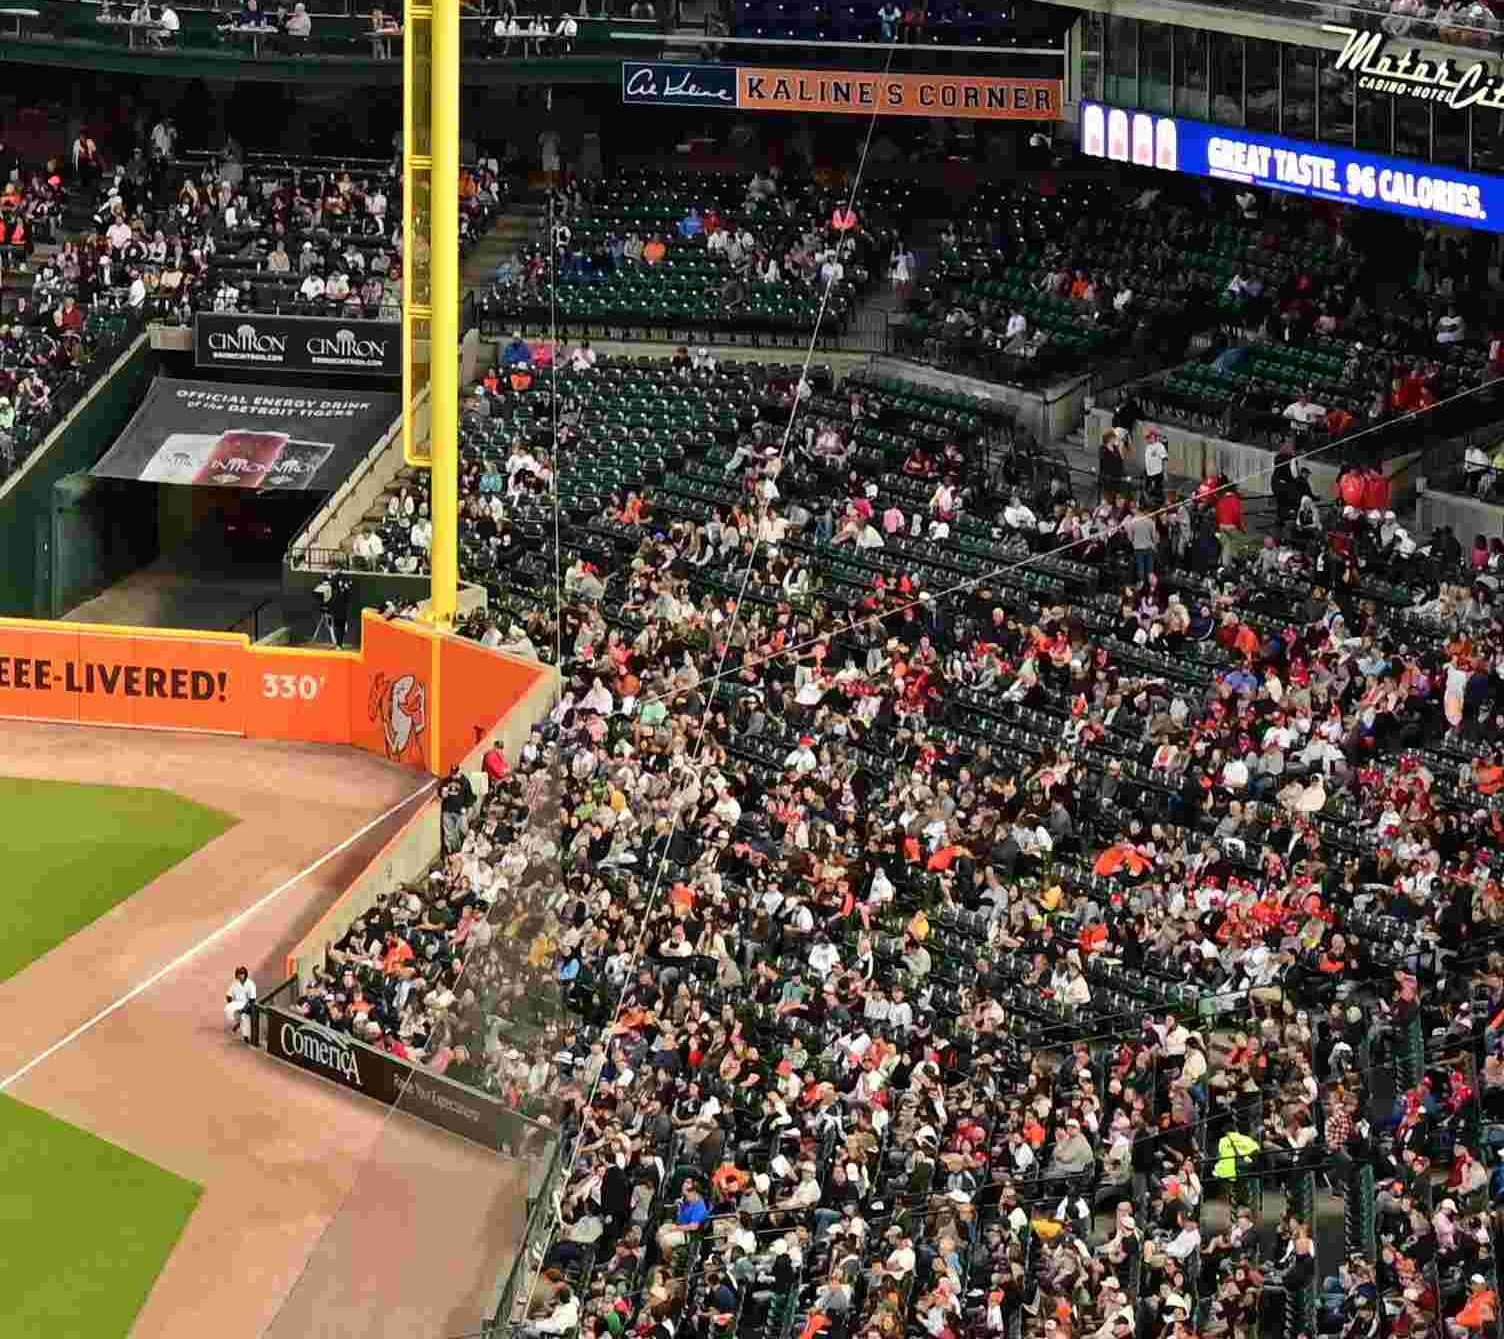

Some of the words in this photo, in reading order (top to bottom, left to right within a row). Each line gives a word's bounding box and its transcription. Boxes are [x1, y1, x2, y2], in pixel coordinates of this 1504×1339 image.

[1321, 25, 1460, 87] Motor
[747, 75, 904, 106] KALINE'S
[918, 82, 1052, 112] CORNER
[1207, 136, 1272, 178] GREAT
[1345, 164, 1377, 196] 96
[1378, 167, 1487, 221] CALORIES.
[176, 388, 248, 405] OFFICIAL
[253, 395, 317, 408] ENERGY
[319, 400, 371, 411] DRINK
[227, 404, 295, 417] DETROIT
[299, 407, 355, 418] TIGERS
